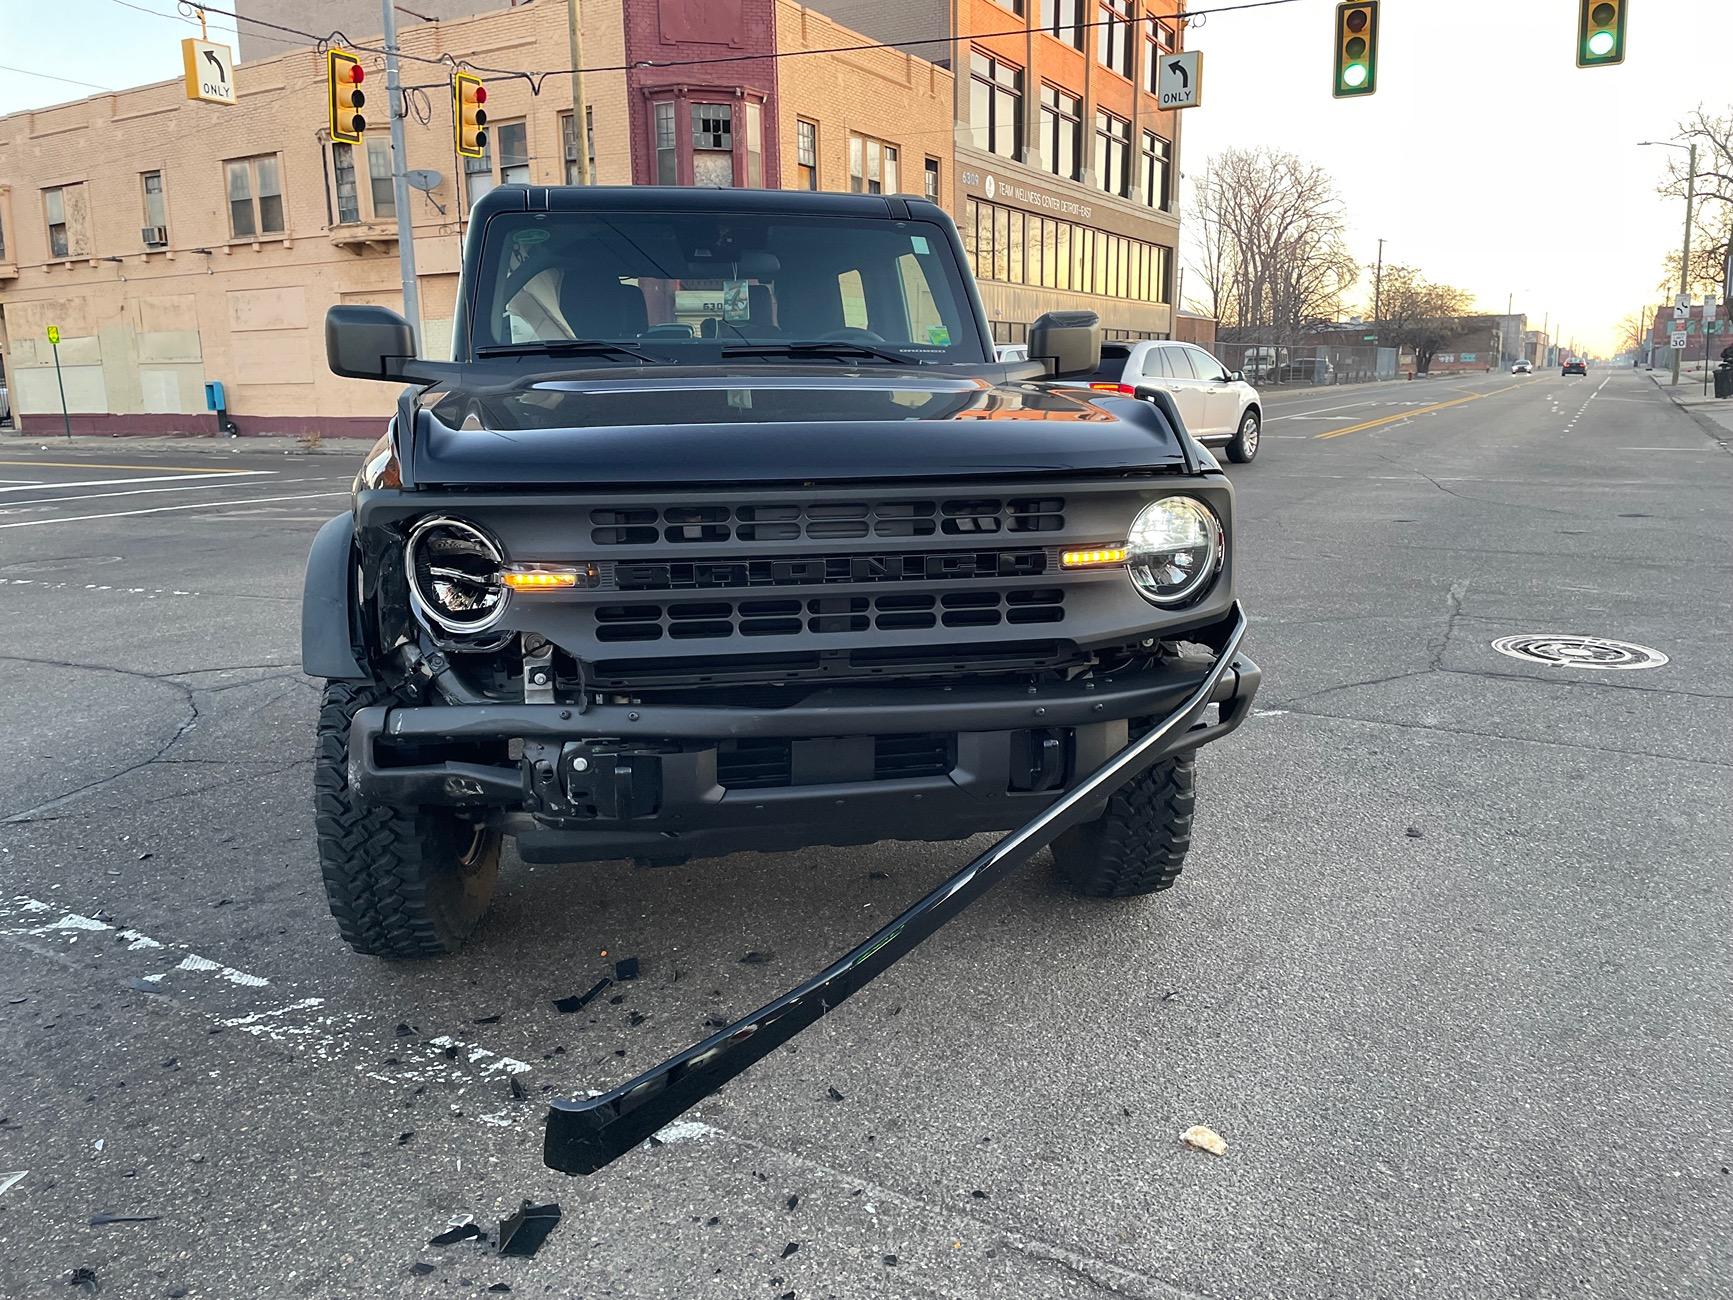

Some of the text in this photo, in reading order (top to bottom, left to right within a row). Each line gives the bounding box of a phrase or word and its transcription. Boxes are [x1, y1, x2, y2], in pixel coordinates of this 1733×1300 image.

[203, 83, 230, 98] ONLY
[1163, 90, 1191, 104] ONLY
[998, 182, 1014, 198] TEAM
[1014, 187, 1041, 206] WELLNESS
[1042, 195, 1060, 210] CENTER
[614, 552, 1046, 587] BRONCO
